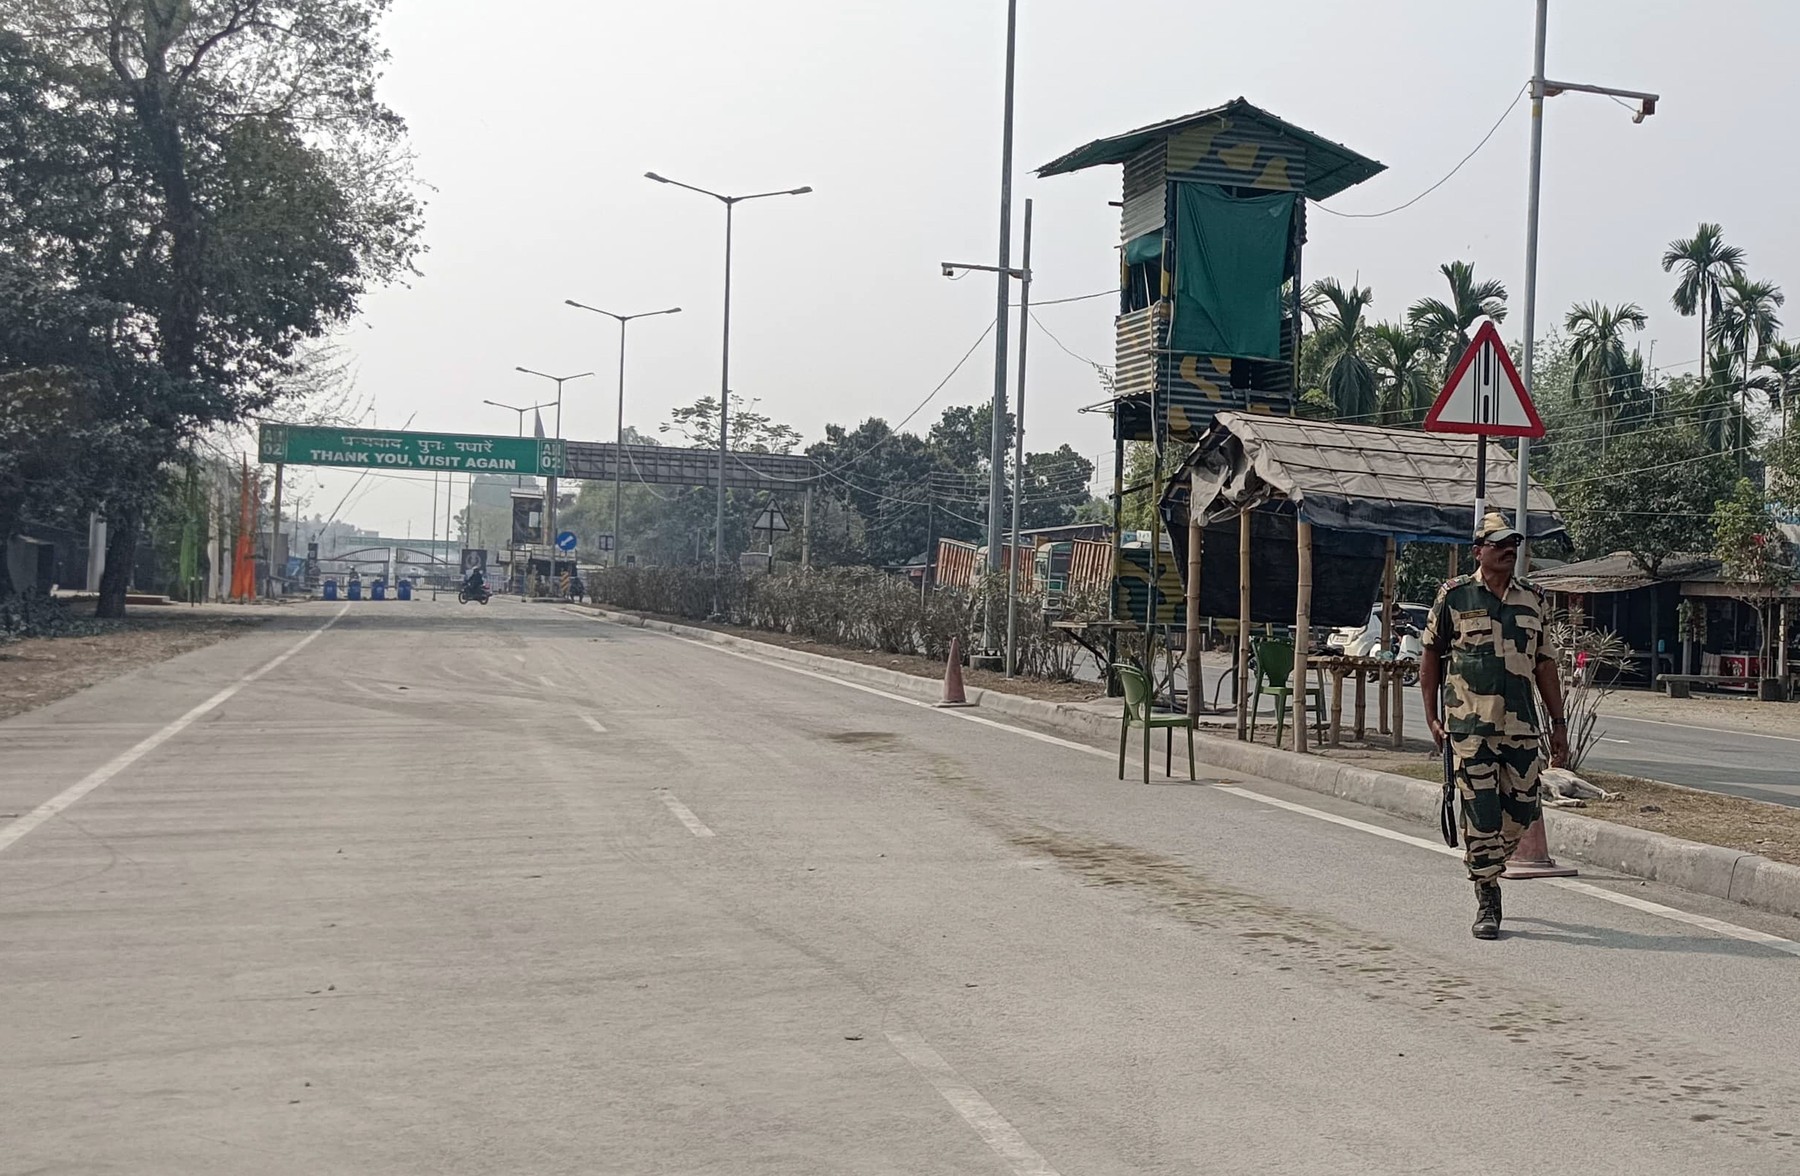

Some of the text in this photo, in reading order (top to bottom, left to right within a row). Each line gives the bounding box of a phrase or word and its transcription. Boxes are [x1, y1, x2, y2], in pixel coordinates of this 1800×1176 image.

[263, 442, 283, 456] 02
[417, 440, 446, 454] पुनः
[454, 439, 494, 453] पधारें
[310, 449, 516, 470] THANK YOU, VISIT AGAIN
[542, 456, 561, 468] 02
